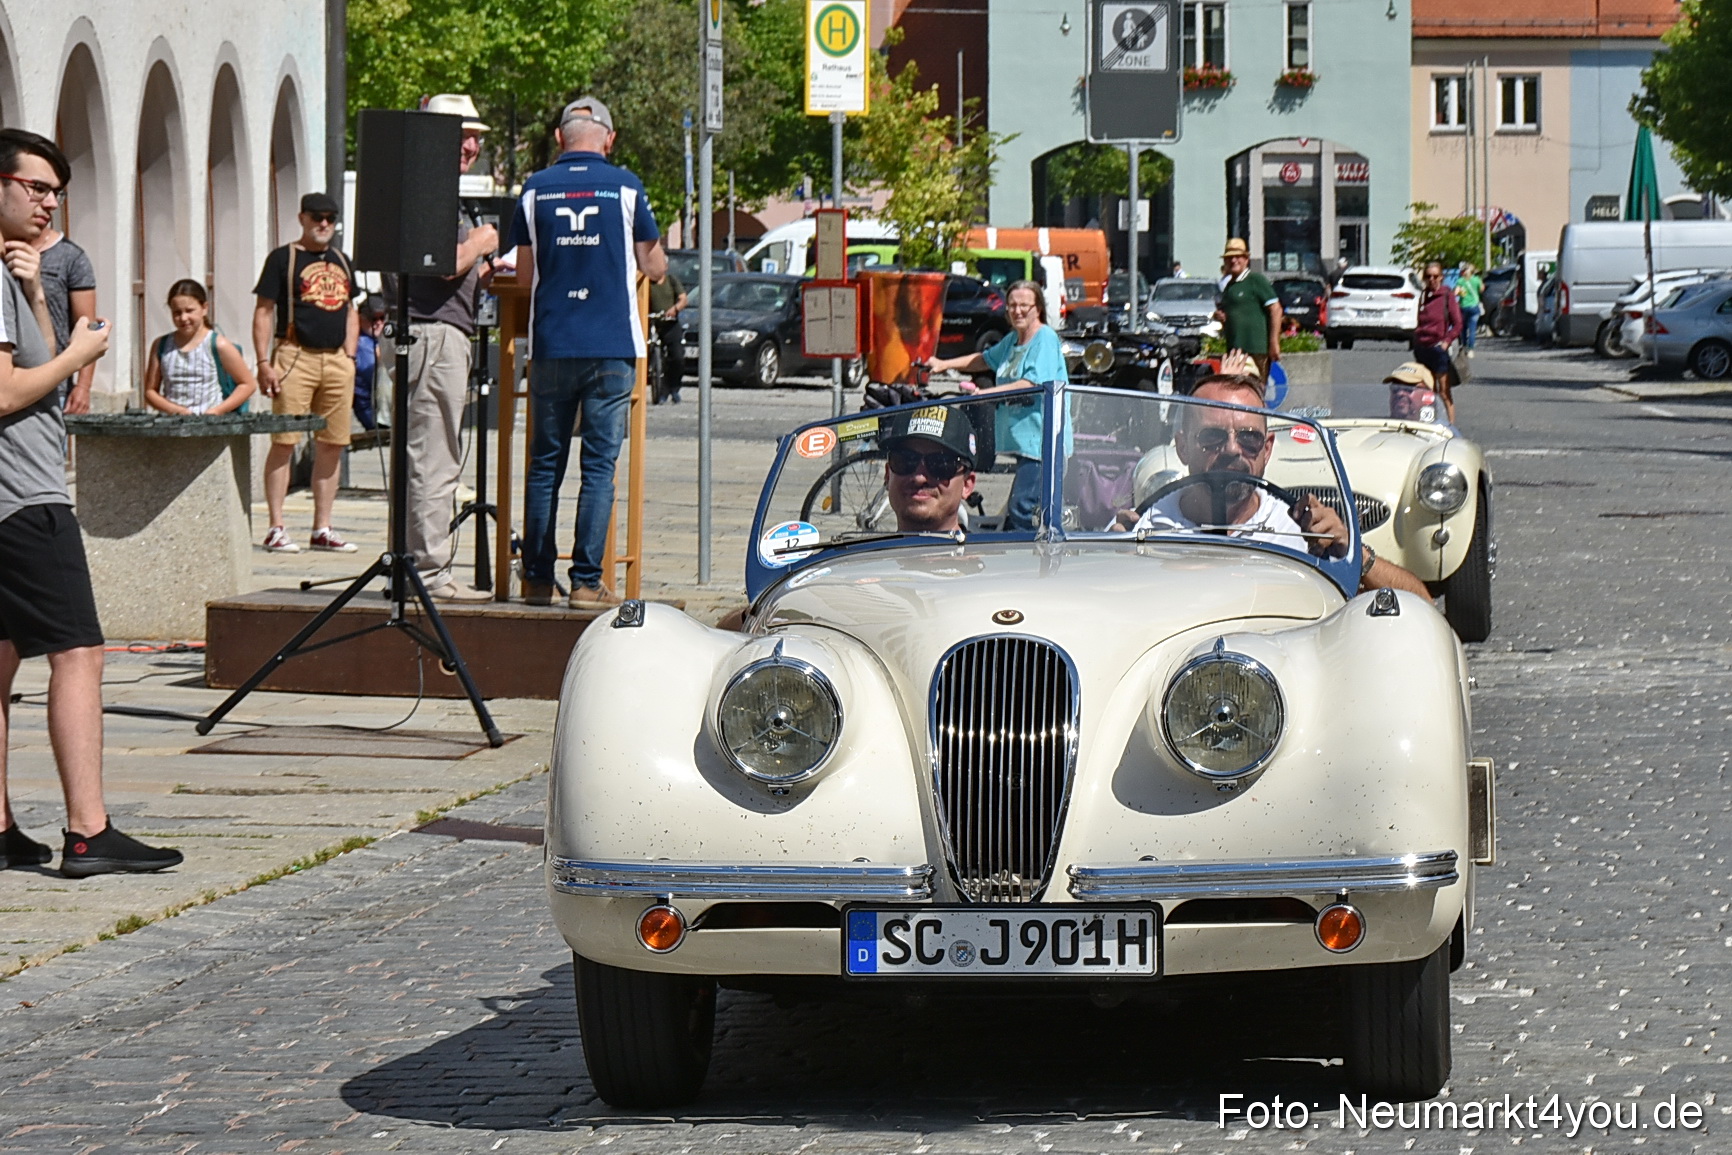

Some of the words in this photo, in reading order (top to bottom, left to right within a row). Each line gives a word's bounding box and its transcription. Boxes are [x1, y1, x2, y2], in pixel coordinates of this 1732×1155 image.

[822, 63, 852, 72] Rathaus
[1117, 55, 1151, 67] ZONE
[1592, 206, 1619, 218] HELD
[556, 233, 600, 246] randstad
[911, 406, 949, 422] 2020
[909, 417, 945, 431] CHAMPIONS
[808, 433, 826, 452] E
[784, 537, 800, 549] 12
[882, 919, 945, 966] SC
[858, 948, 869, 962] D
